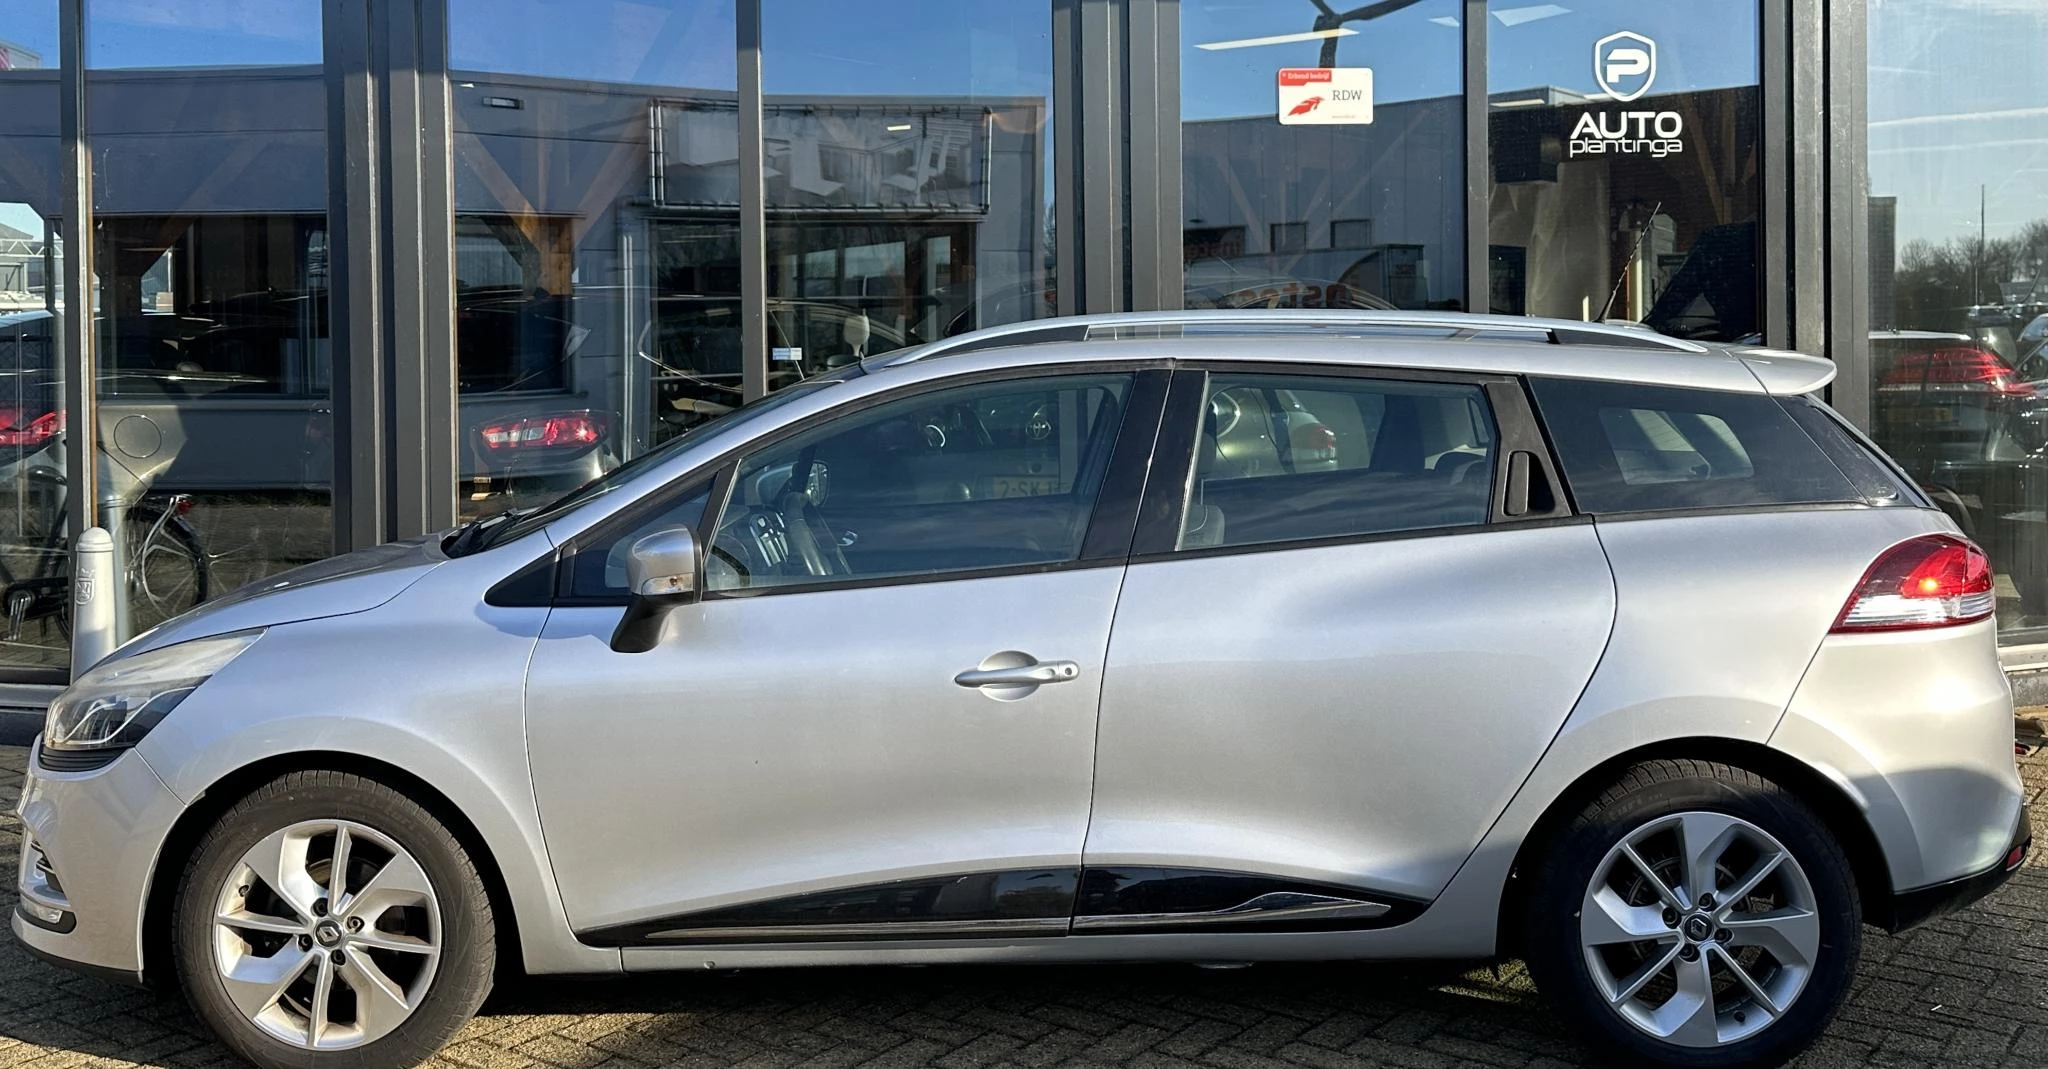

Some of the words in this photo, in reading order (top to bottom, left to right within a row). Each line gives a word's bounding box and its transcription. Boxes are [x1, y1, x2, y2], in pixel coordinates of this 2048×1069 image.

[1606, 48, 1650, 83] P
[1332, 89, 1363, 101] RDW
[1570, 111, 1683, 139] AUTO
[1569, 137, 1683, 158] plantinga
